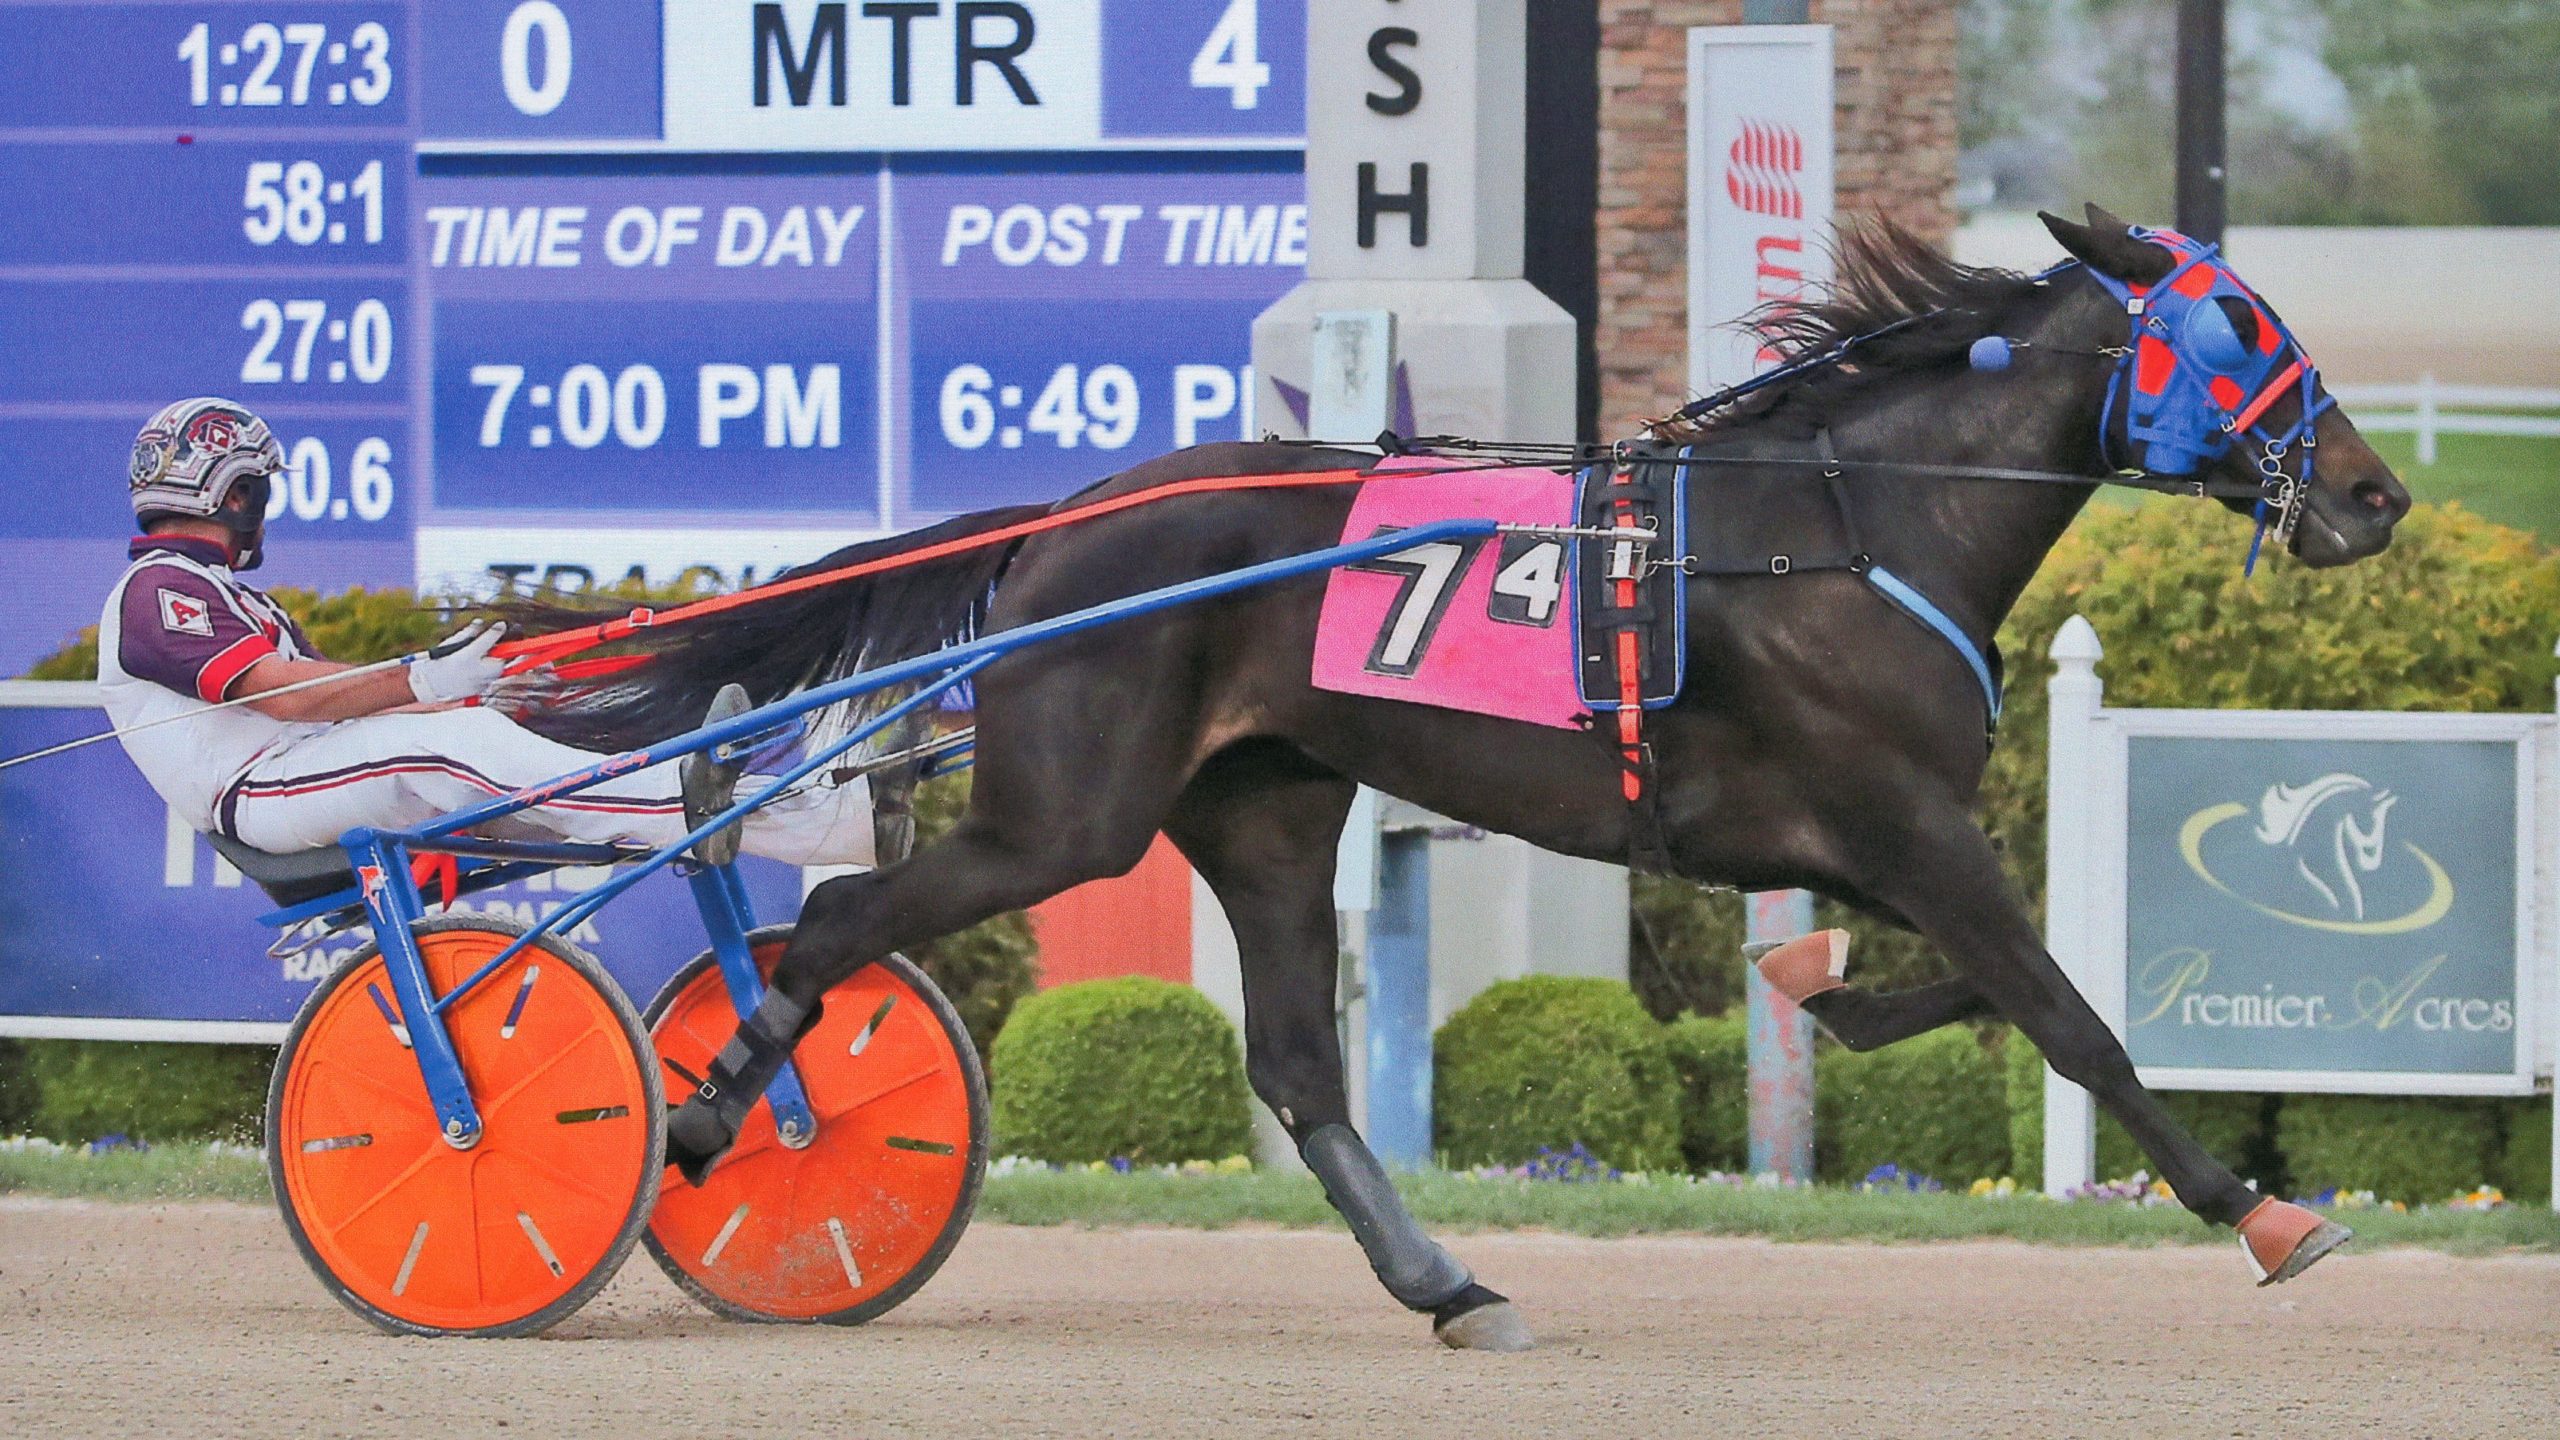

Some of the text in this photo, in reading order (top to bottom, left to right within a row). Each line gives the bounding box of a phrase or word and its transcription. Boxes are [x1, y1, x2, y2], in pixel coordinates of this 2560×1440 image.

[178, 22, 392, 106] 1:27:3
[502, 0, 572, 116] 0
[753, 2, 1042, 106] MTR
[1190, 0, 1271, 110] 4
[1357, 0, 1428, 248] SH
[243, 160, 383, 244] 58:1
[425, 206, 864, 267] TIME OF DAY
[941, 205, 1308, 266] POST TIME
[241, 299, 392, 383] 27:0
[470, 364, 841, 448] 7:00 PM
[939, 364, 1253, 449] 6:49 P
[170, 599, 201, 626] A
[1362, 533, 1476, 673] 7
[1495, 540, 1563, 621] 4
[2129, 947, 2514, 1031] Premier Acres
